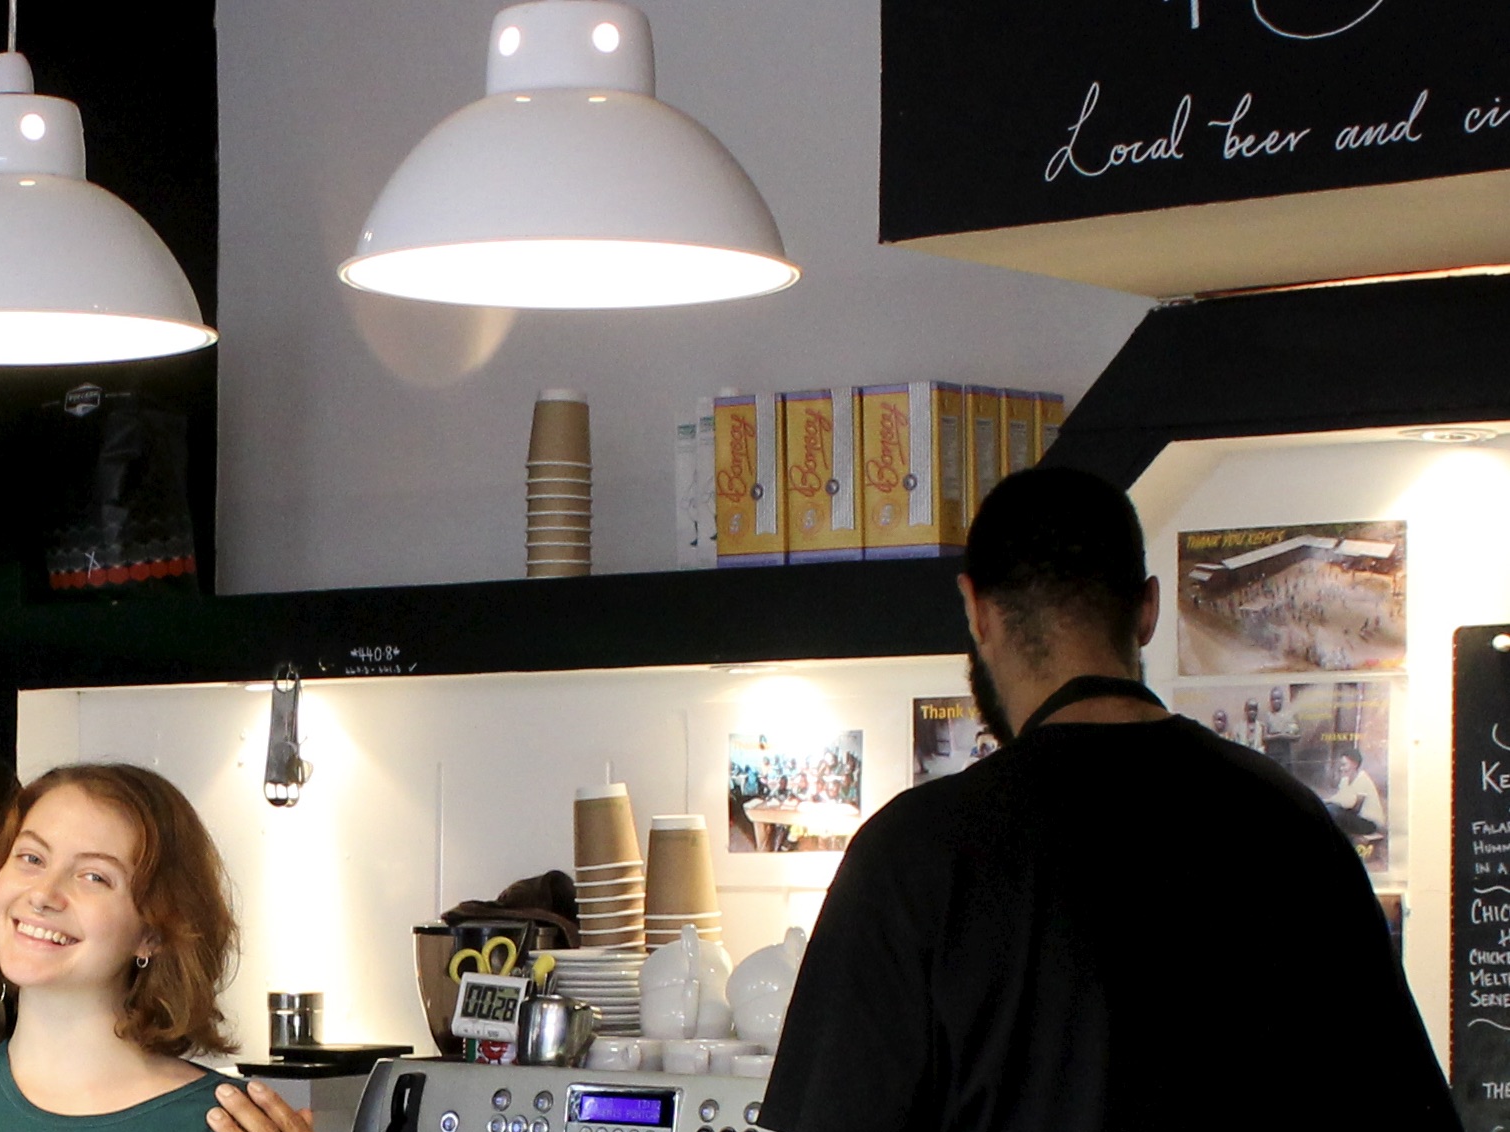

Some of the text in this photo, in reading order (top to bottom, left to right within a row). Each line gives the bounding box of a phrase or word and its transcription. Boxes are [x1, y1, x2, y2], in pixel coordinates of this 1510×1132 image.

[1044, 81, 1429, 182] Local beer and
[920, 704, 963, 720] Thank
[1475, 862, 1508, 874] IN A
